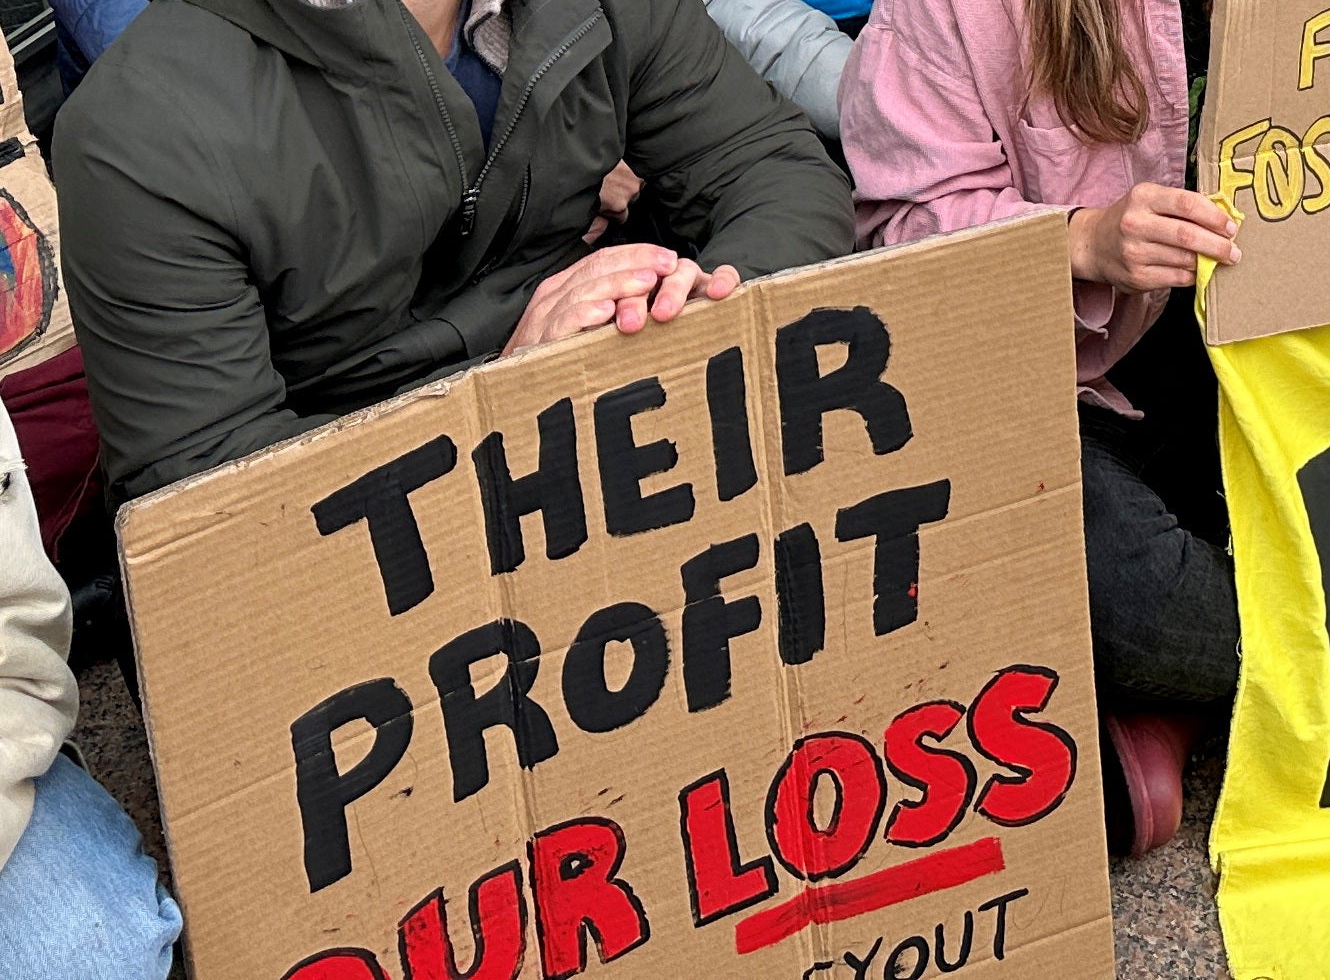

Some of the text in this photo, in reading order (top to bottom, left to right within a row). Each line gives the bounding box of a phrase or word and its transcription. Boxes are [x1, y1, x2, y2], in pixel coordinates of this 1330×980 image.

[310, 305, 914, 617] THEIR
[290, 478, 951, 894] PROFIT
[677, 663, 1077, 928] LOSS
